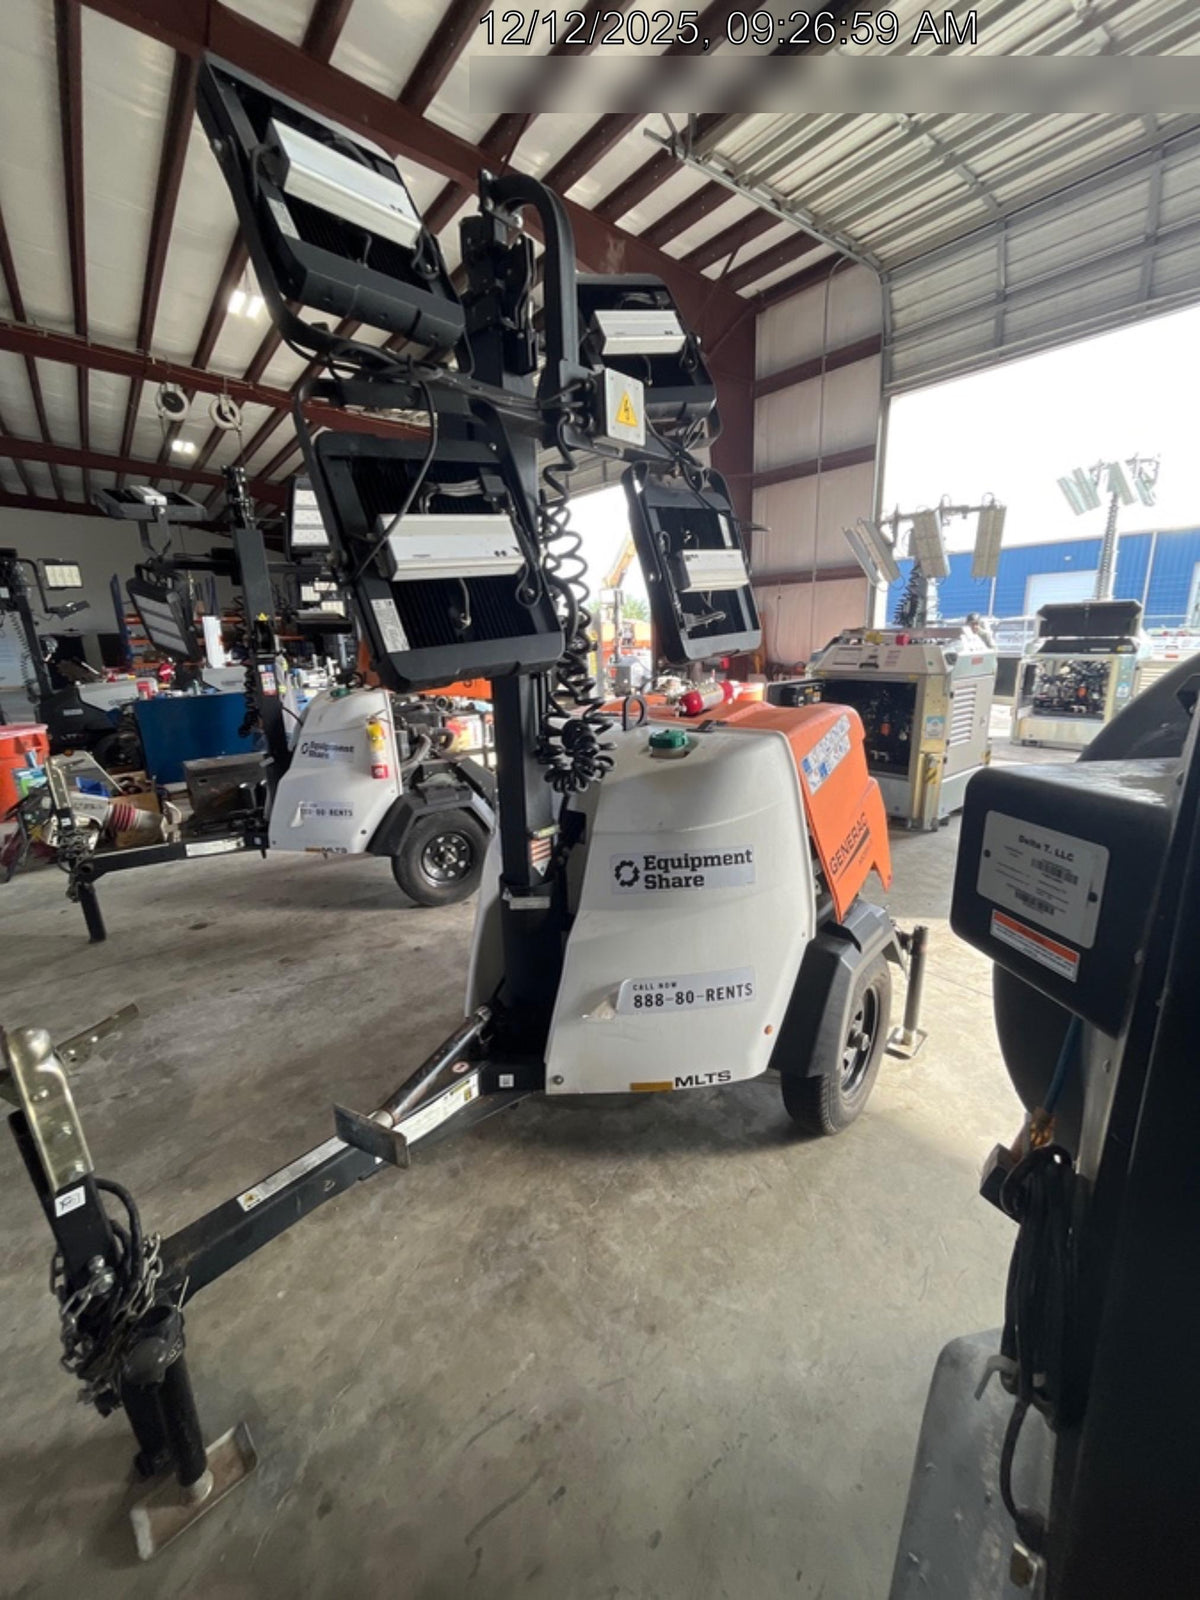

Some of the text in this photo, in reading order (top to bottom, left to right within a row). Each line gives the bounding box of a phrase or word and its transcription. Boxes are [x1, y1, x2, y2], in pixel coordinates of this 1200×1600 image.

[829, 812, 868, 875] GENERAC
[643, 849, 753, 873] Equipment
[1054, 848, 1074, 862] LLC
[644, 874, 704, 890] Share
[632, 982, 677, 991] CALL NOW
[634, 983, 753, 1008] 888-80-RENTS
[675, 1070, 731, 1088] MLTS
